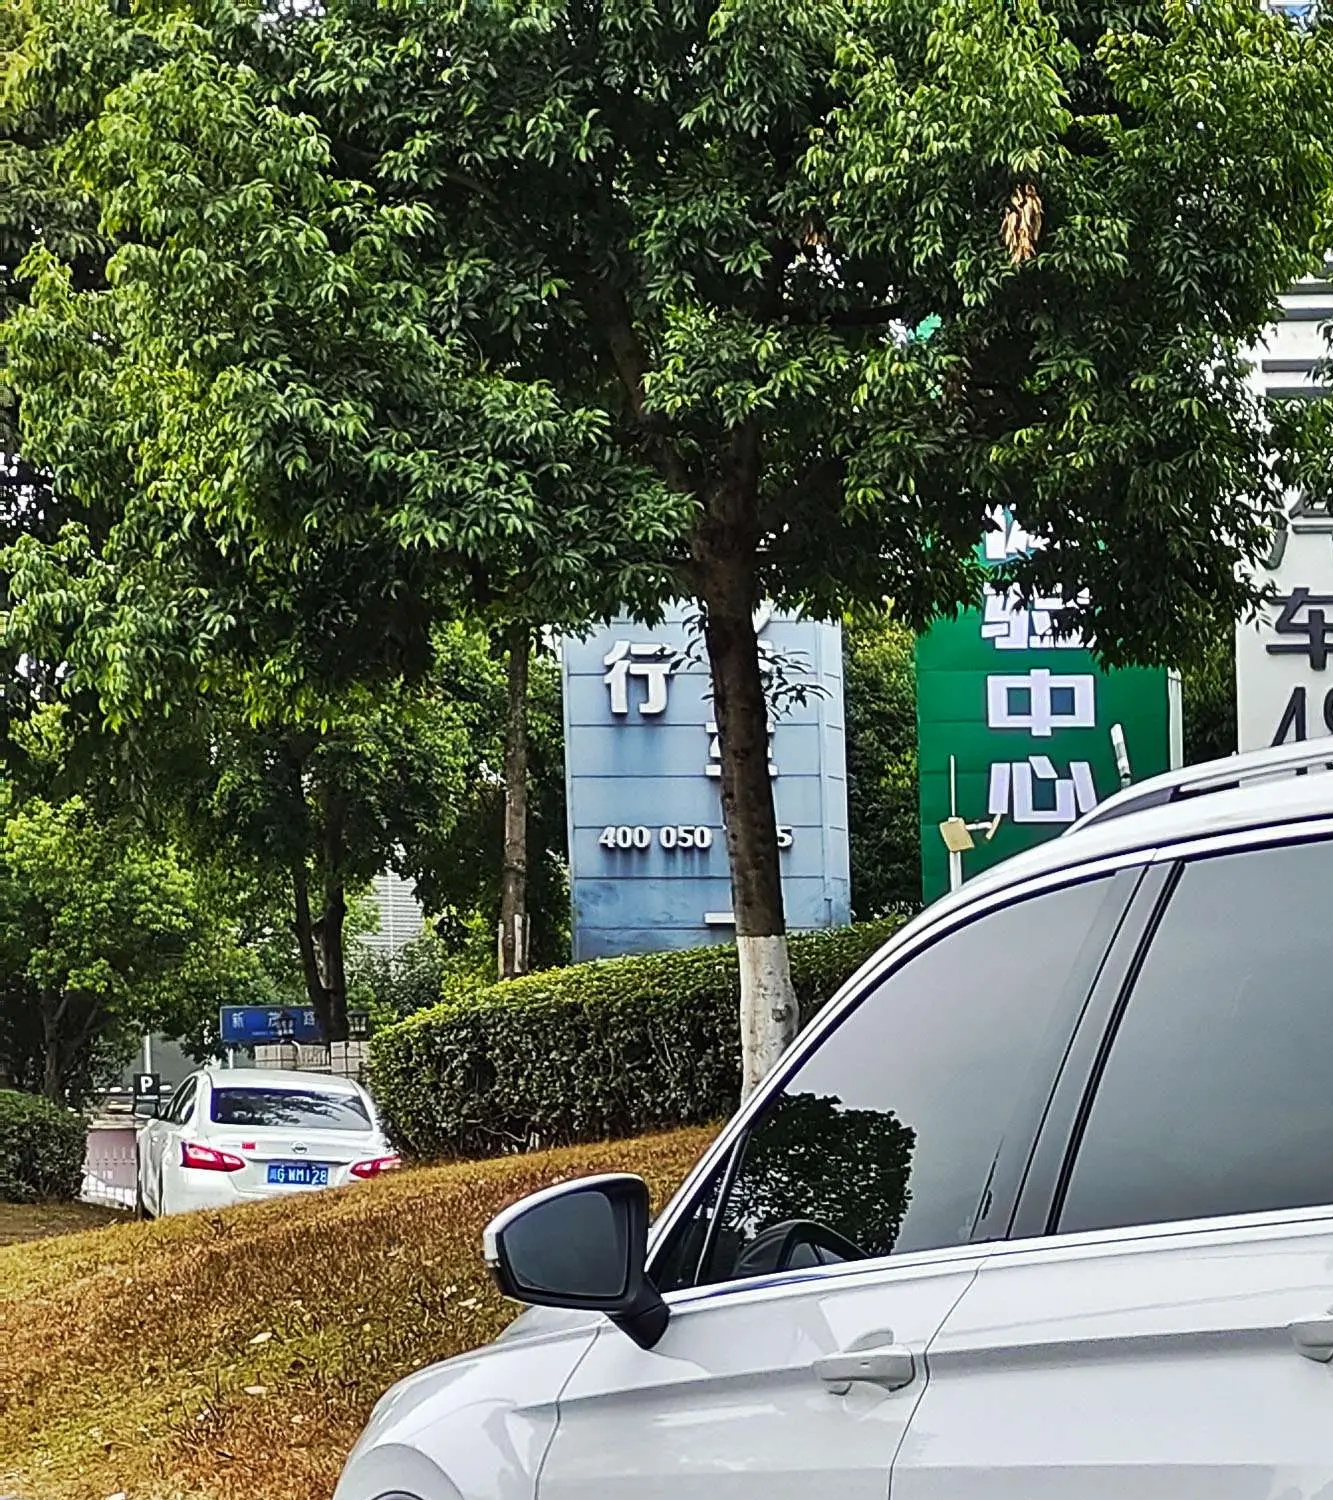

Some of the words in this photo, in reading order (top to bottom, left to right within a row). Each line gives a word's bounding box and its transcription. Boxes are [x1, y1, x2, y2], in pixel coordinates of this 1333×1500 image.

[599, 825, 651, 848] 400
[659, 825, 712, 848] 050
[140, 1076, 153, 1093] P
